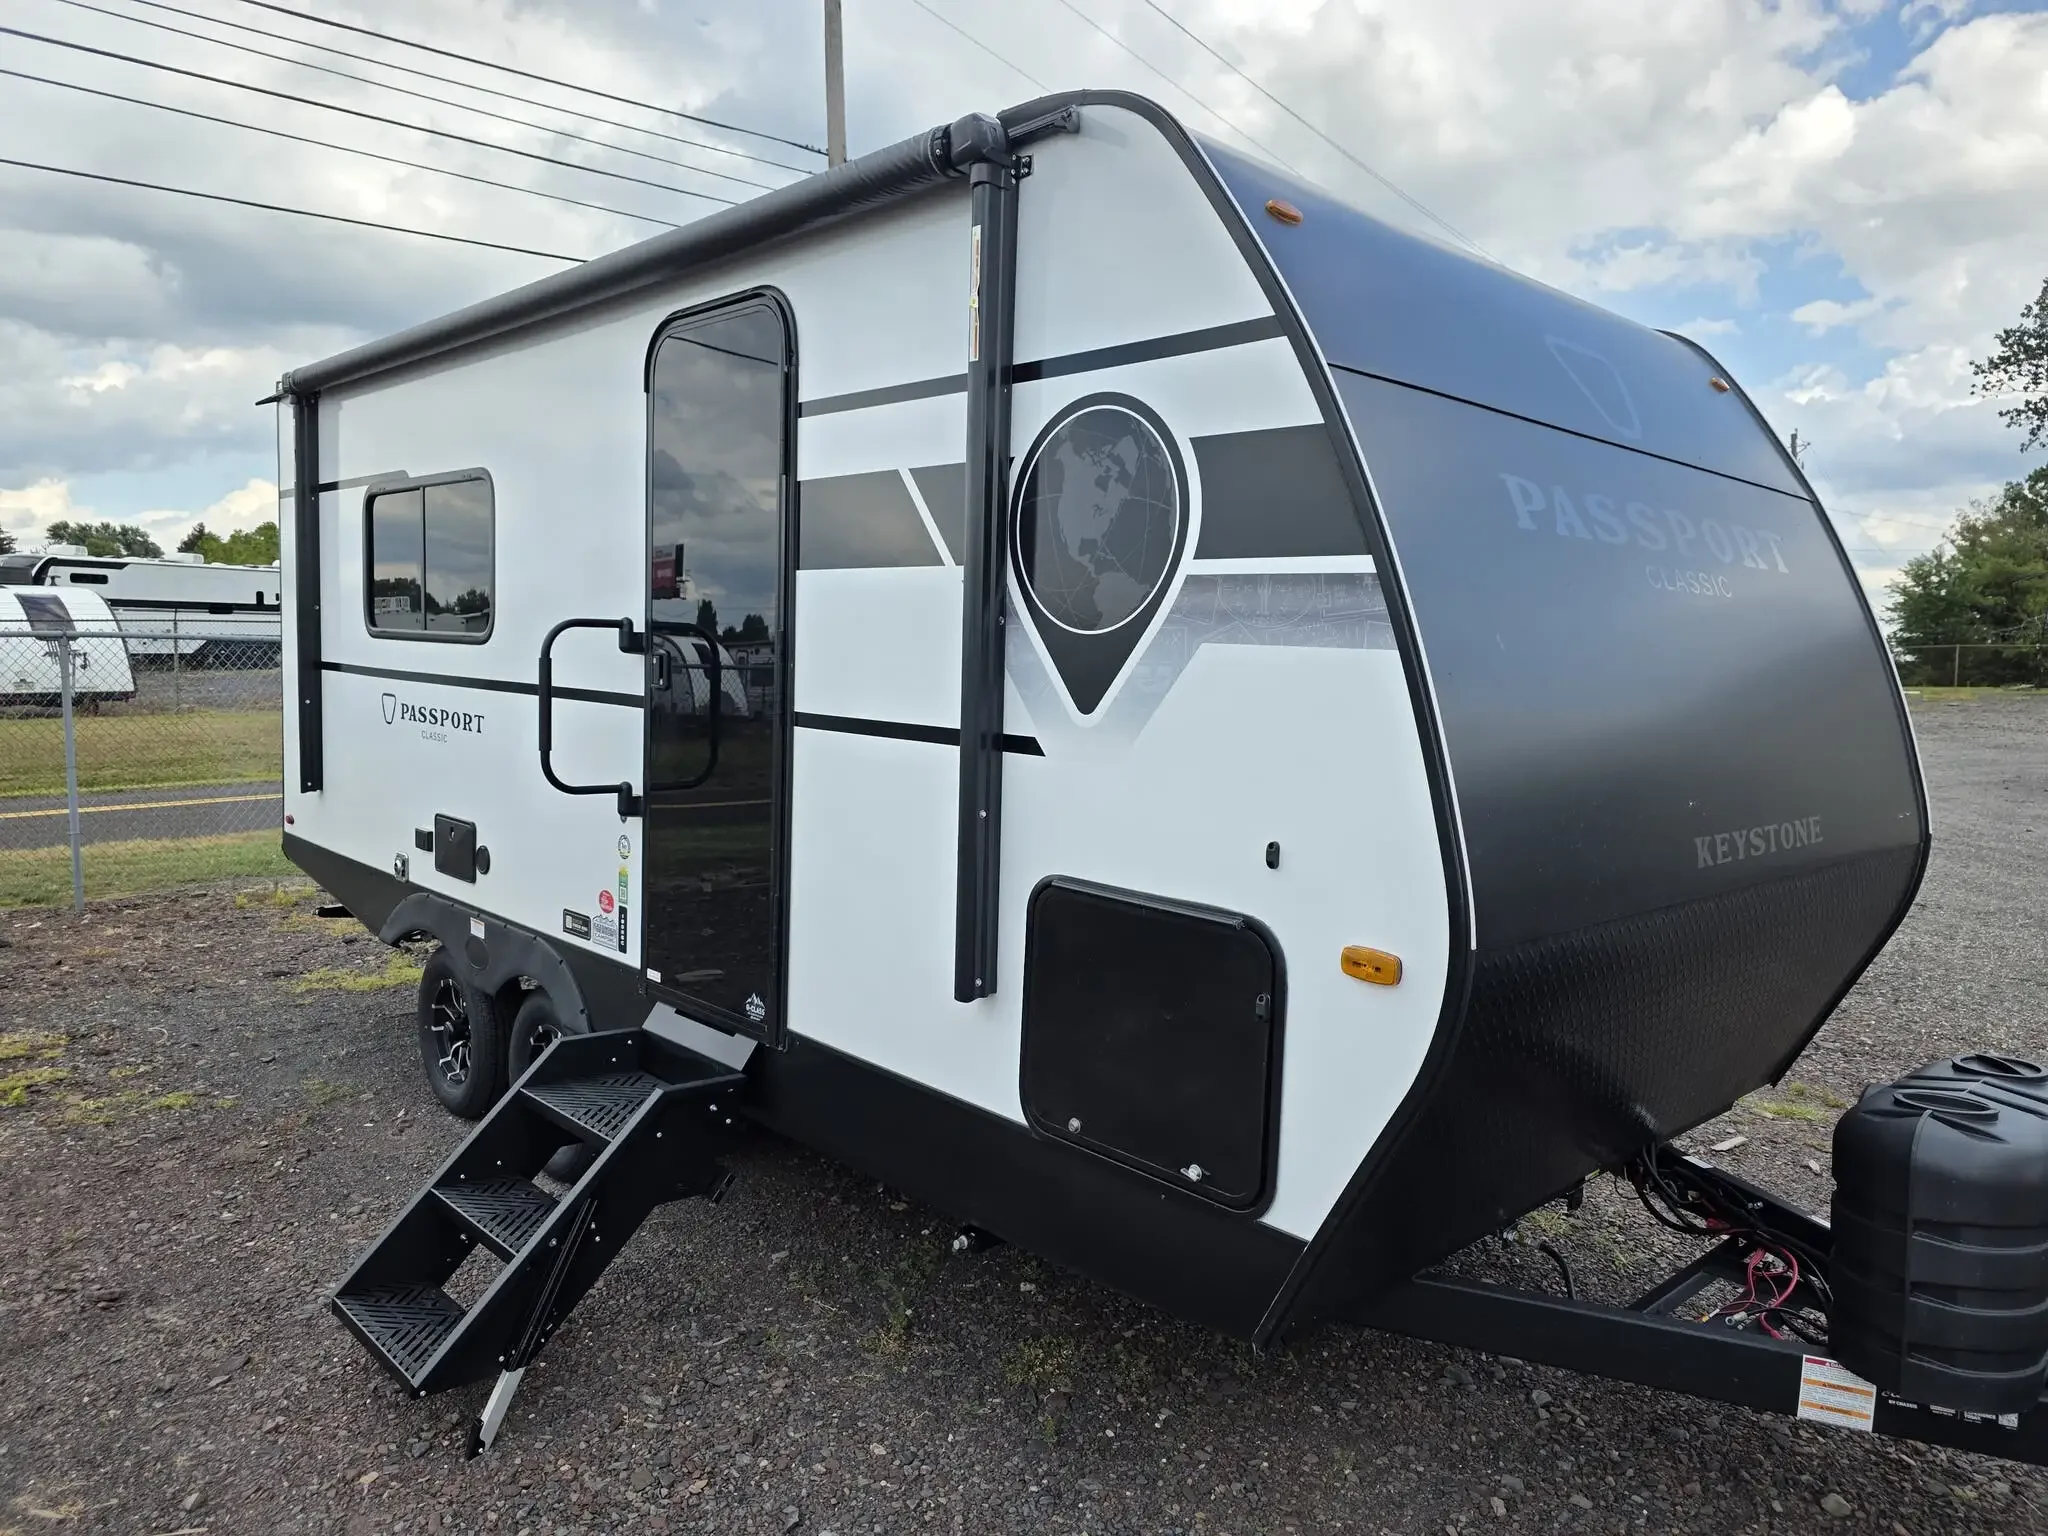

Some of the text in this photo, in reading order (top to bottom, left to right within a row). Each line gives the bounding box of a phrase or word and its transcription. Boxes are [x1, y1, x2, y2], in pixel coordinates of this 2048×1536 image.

[1500, 473, 1789, 574] PASSPORT
[1646, 565, 1732, 598] CLASSIC
[400, 703, 484, 733] PASSPORT
[421, 730, 447, 743] CLASSIC
[1693, 815, 1823, 869] KEYSTONE
